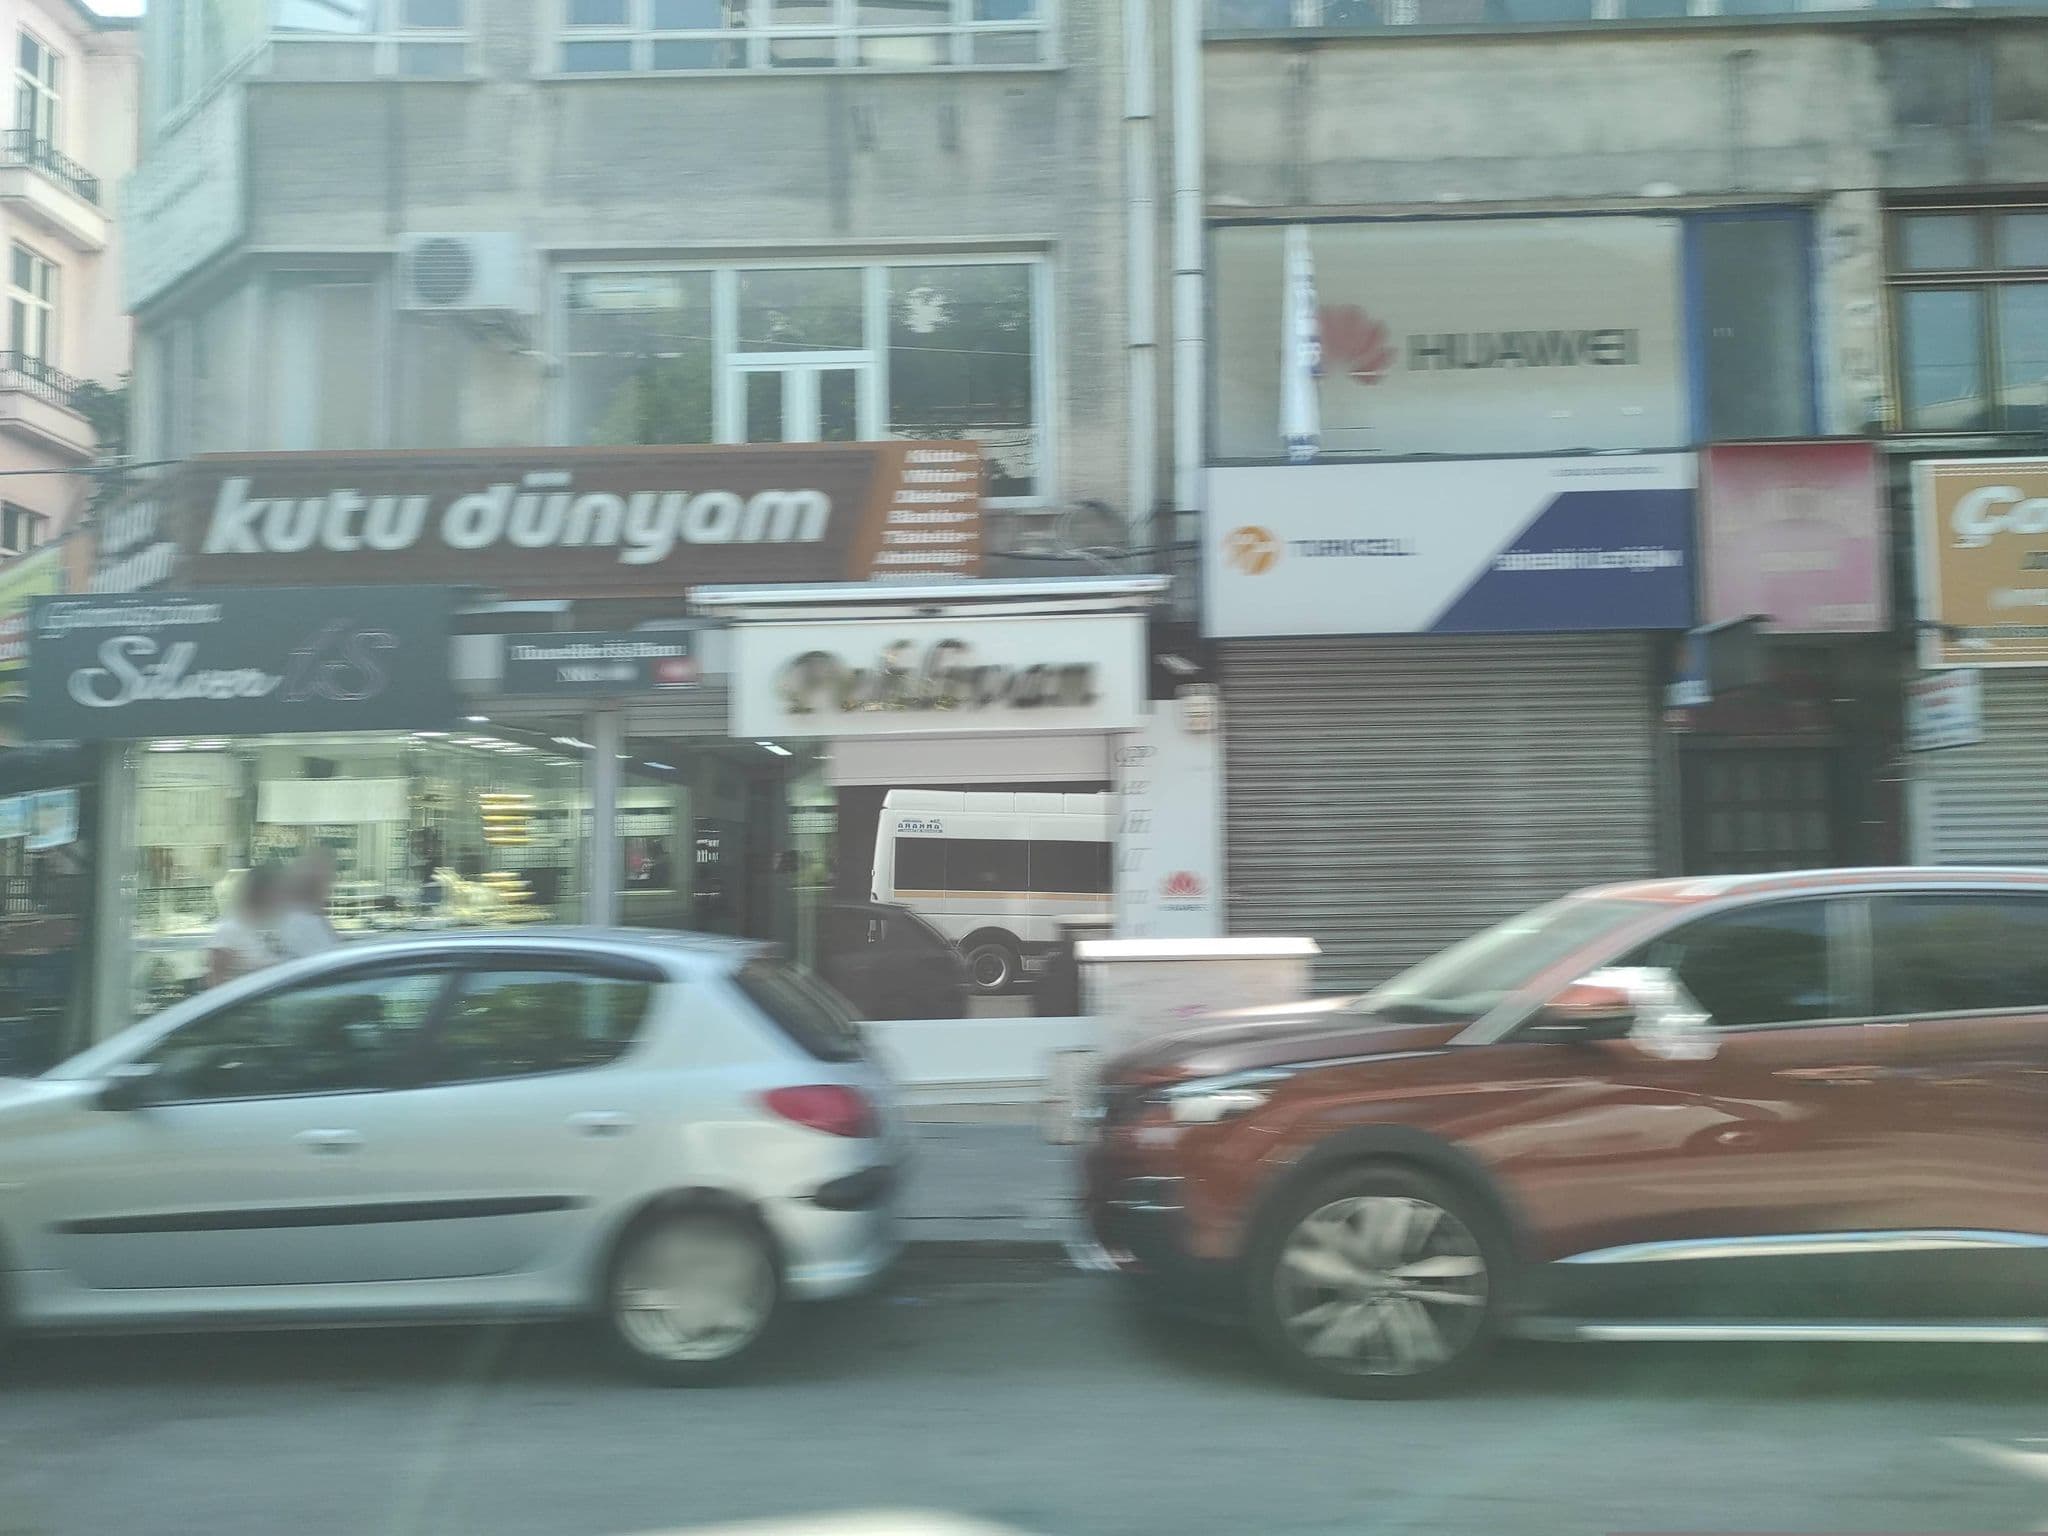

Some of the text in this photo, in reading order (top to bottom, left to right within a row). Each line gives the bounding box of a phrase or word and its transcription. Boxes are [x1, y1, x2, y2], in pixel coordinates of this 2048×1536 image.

[1406, 327, 1640, 372] HUAWEI
[203, 476, 432, 554] kutu
[440, 470, 832, 565] dünyam
